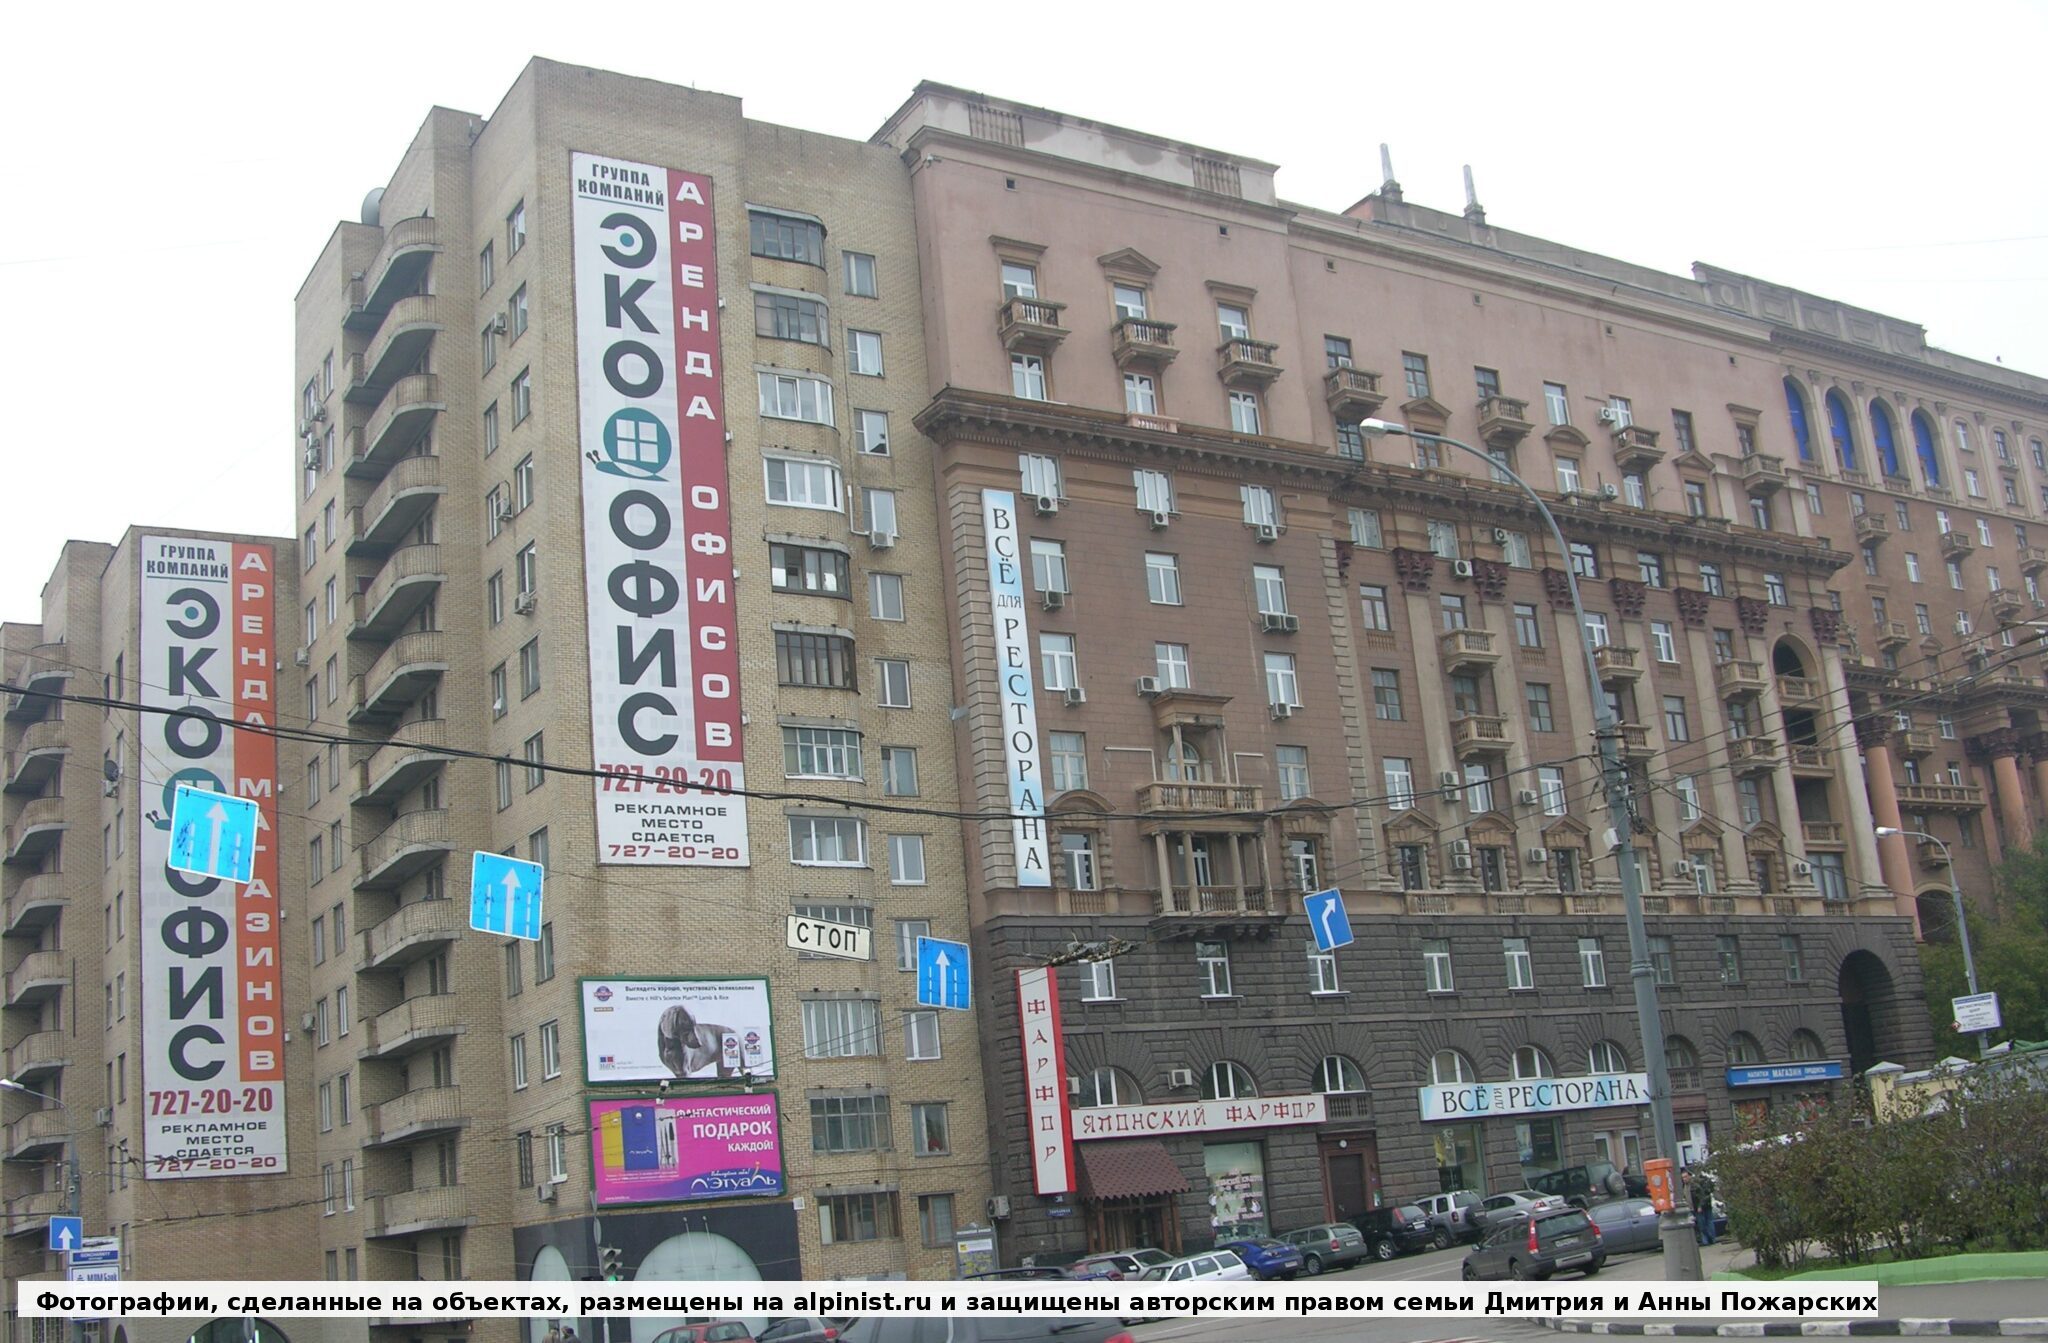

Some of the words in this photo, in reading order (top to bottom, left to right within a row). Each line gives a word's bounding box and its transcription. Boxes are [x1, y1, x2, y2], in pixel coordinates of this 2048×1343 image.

[592, 164, 650, 187] ГРУППА
[578, 179, 664, 206] КОМПАНИЙ
[676, 181, 715, 421] АРЕНДА
[161, 545, 215, 561] ГРУППА
[993, 508, 1015, 585] ВСЁ
[147, 560, 228, 578] КОМПАНИЙ
[691, 485, 732, 748] ОФИСОВ
[240, 552, 271, 733] АРЕНДА
[1005, 618, 1043, 870] РЕСТОРАНА
[600, 763, 732, 797] 727-20-20
[614, 803, 727, 817] РЕКЛАМНОЕ
[641, 818, 703, 830] МЕСТО
[632, 832, 715, 844] СДАЕТСЯ
[608, 844, 739, 860] 727-20-20
[239, 777, 276, 1071] МАЗИНОВ
[797, 922, 856, 952] СТОП
[1027, 999, 1056, 1162] ФАРФОР
[149, 1087, 273, 1116] 727-20-20
[1442, 1086, 1489, 1113] ВСЁ
[1508, 1079, 1639, 1109] РЕСТОРАНА
[676, 1104, 771, 1119] ФАНТАСТИЧЕСКИЙ
[1083, 1107, 1207, 1134] ЯПОНСКИЙ
[1226, 1101, 1316, 1123] ФАРФОР
[161, 1121, 267, 1134] РЕКЛАМНОЕ
[693, 1121, 772, 1140] ПОДАРОК
[186, 1134, 244, 1145] МЕСТО
[728, 1140, 774, 1153] КАЖДОЙ!
[176, 1146, 254, 1158] СДАЕТСЯ
[154, 1156, 277, 1173] 727-20-20
